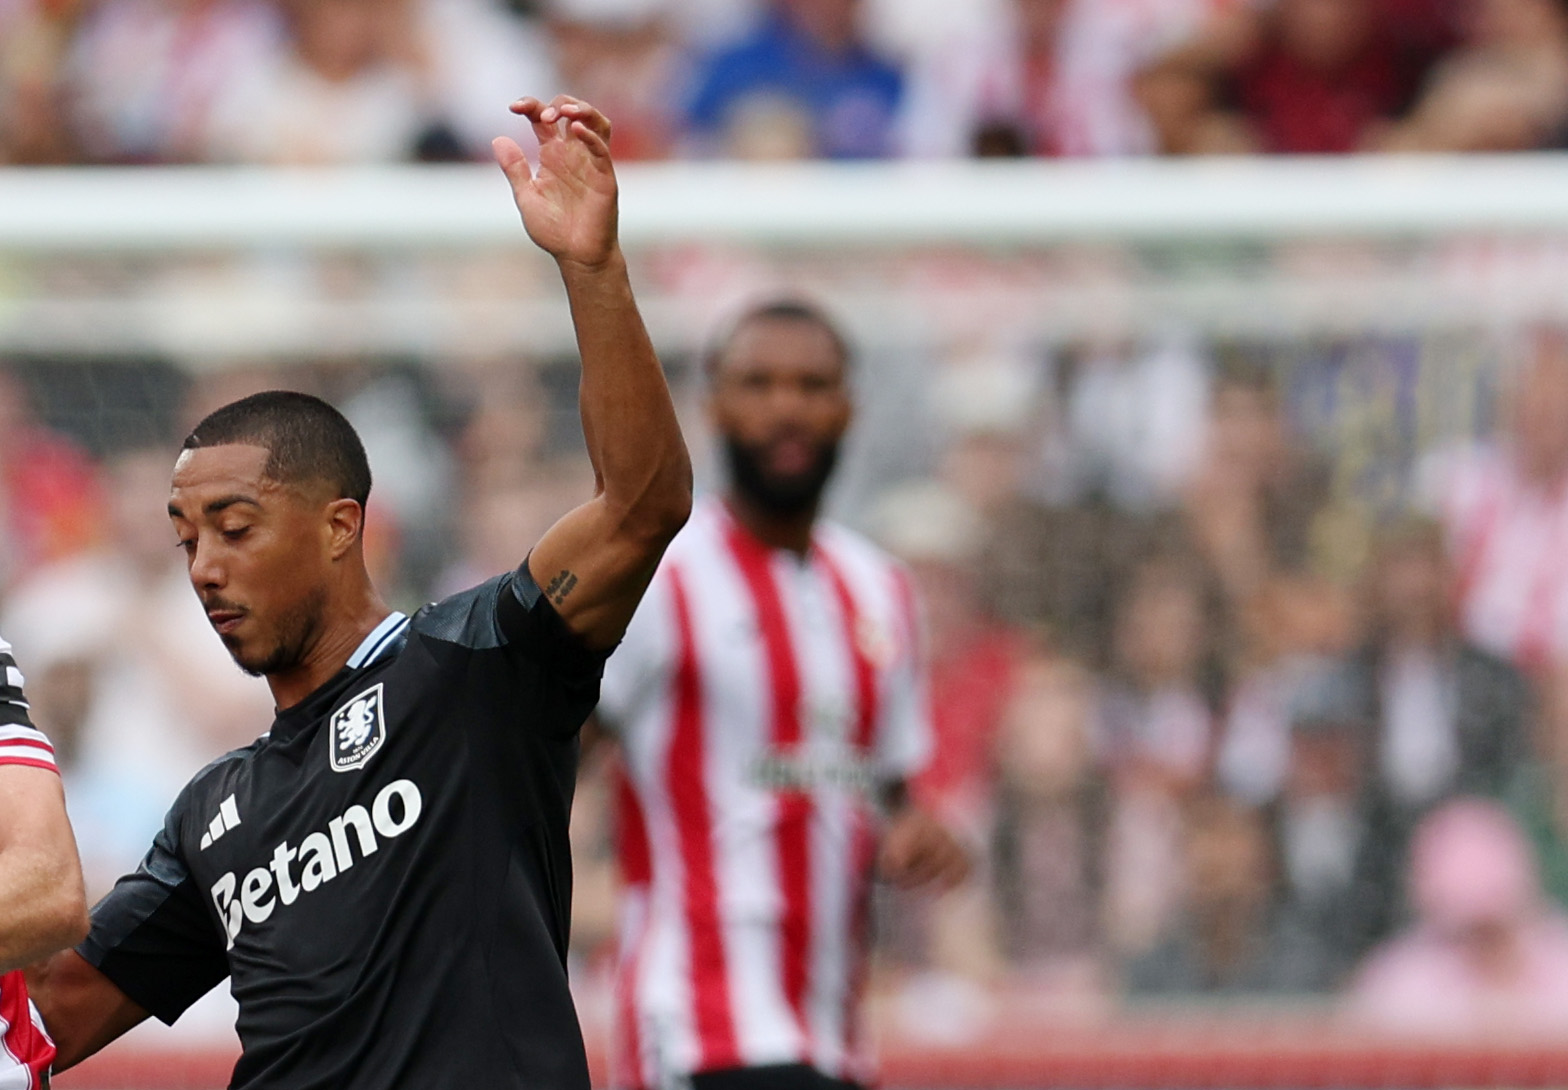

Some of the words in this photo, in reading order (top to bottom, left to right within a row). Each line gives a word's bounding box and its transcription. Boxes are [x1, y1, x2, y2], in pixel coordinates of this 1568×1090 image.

[337, 753, 361, 765] ASTON
[361, 736, 379, 756] VILLA
[210, 779, 422, 951] Betano
